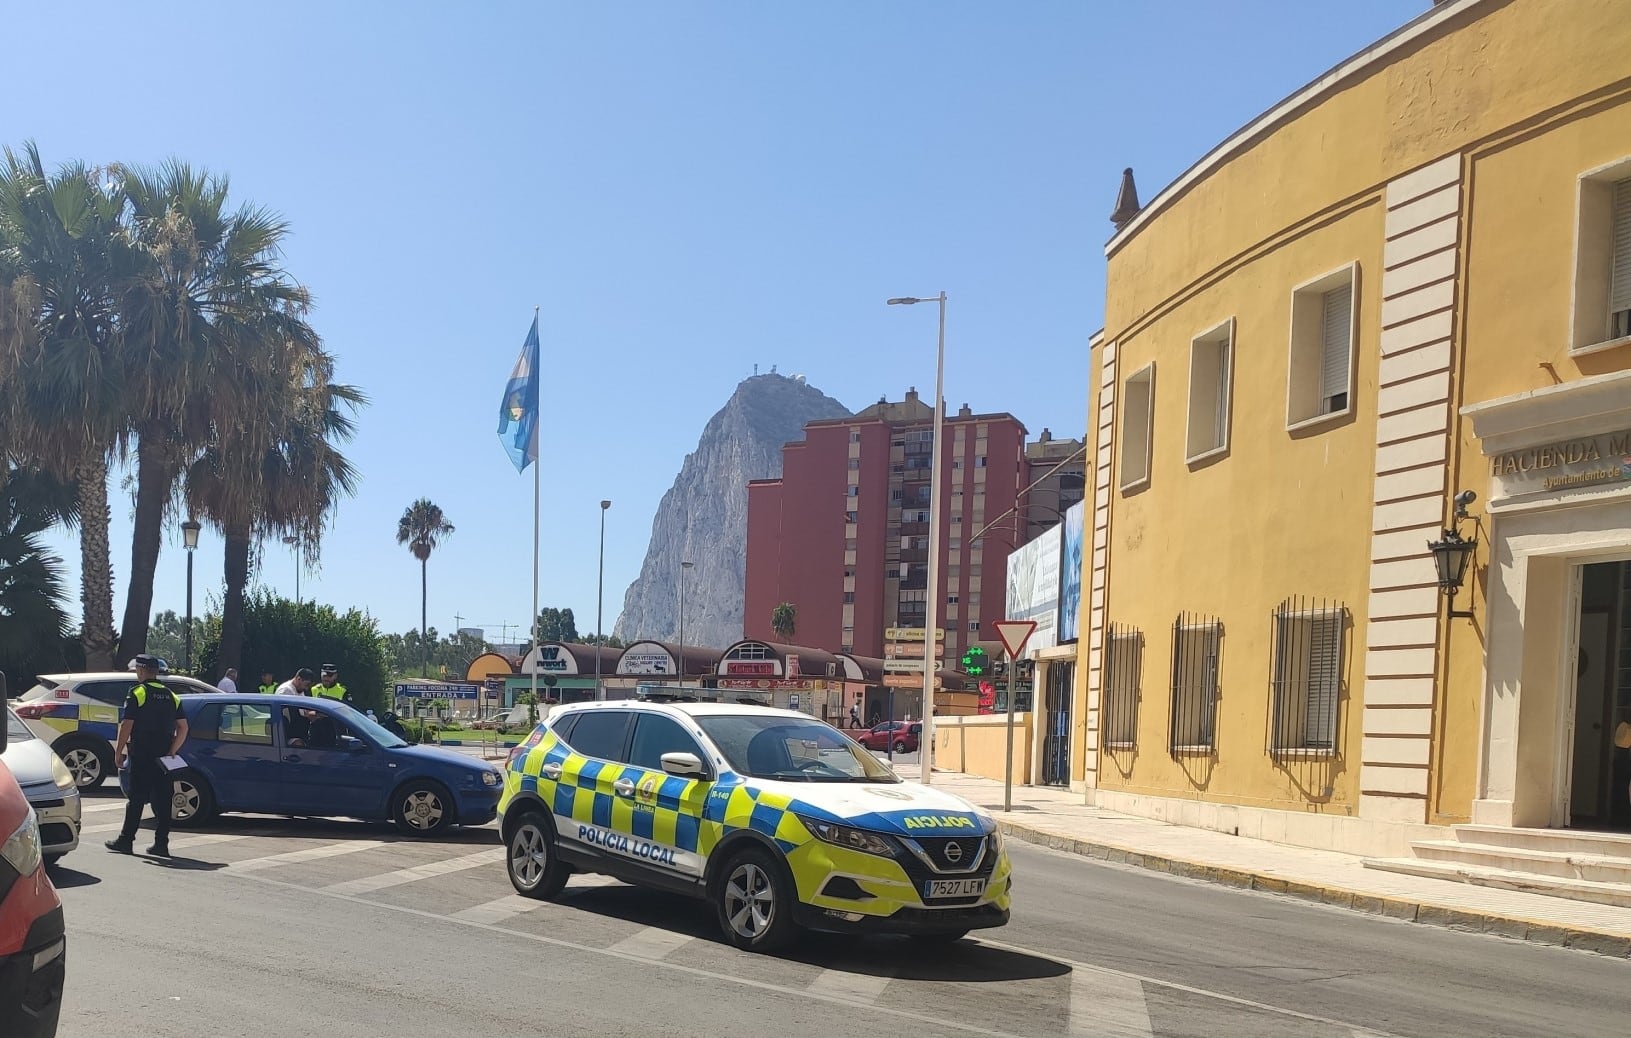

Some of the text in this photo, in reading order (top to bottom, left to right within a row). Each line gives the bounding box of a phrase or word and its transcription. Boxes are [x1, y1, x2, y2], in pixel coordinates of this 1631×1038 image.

[1491, 439, 1601, 477] HACIENDA
[1543, 466, 1621, 489] Ayuntamiento de
[578, 825, 677, 866] POLICIA LOCAL
[932, 881, 961, 895] 7527
